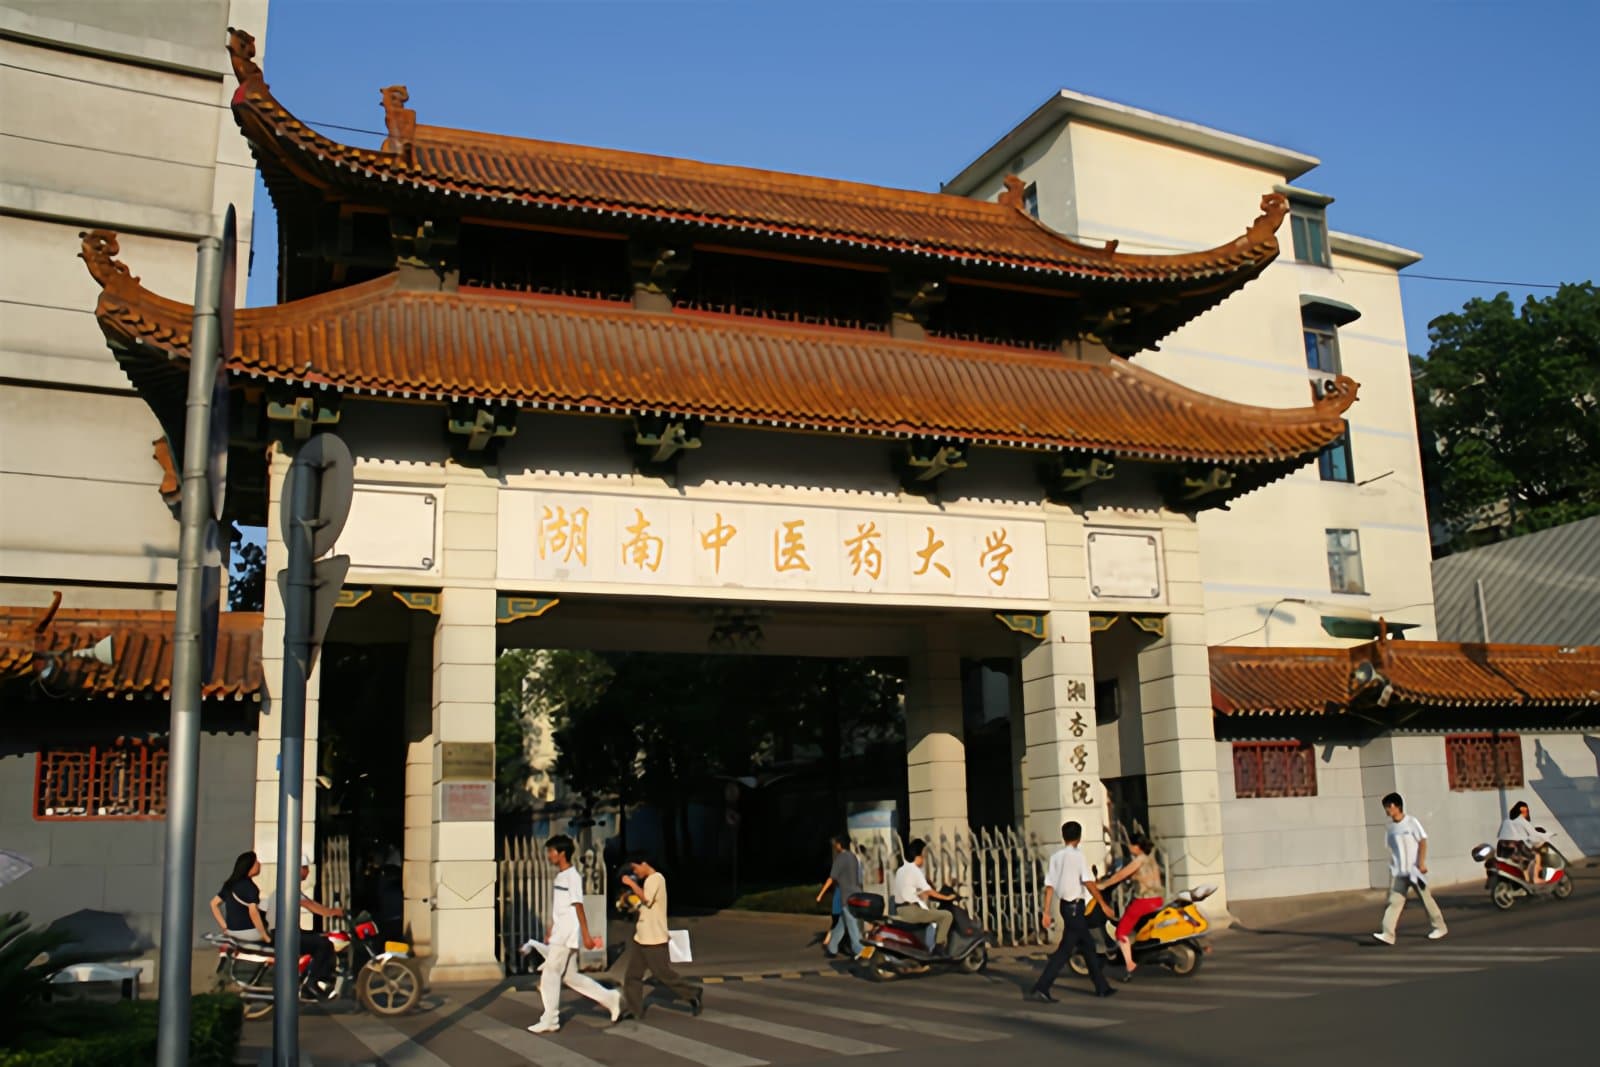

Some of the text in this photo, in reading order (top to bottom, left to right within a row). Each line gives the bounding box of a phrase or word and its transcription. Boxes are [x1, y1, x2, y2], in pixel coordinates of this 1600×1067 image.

[537, 504, 1013, 586] 湖南中医药大学
[1067, 679, 1094, 805] 湘杏学院
